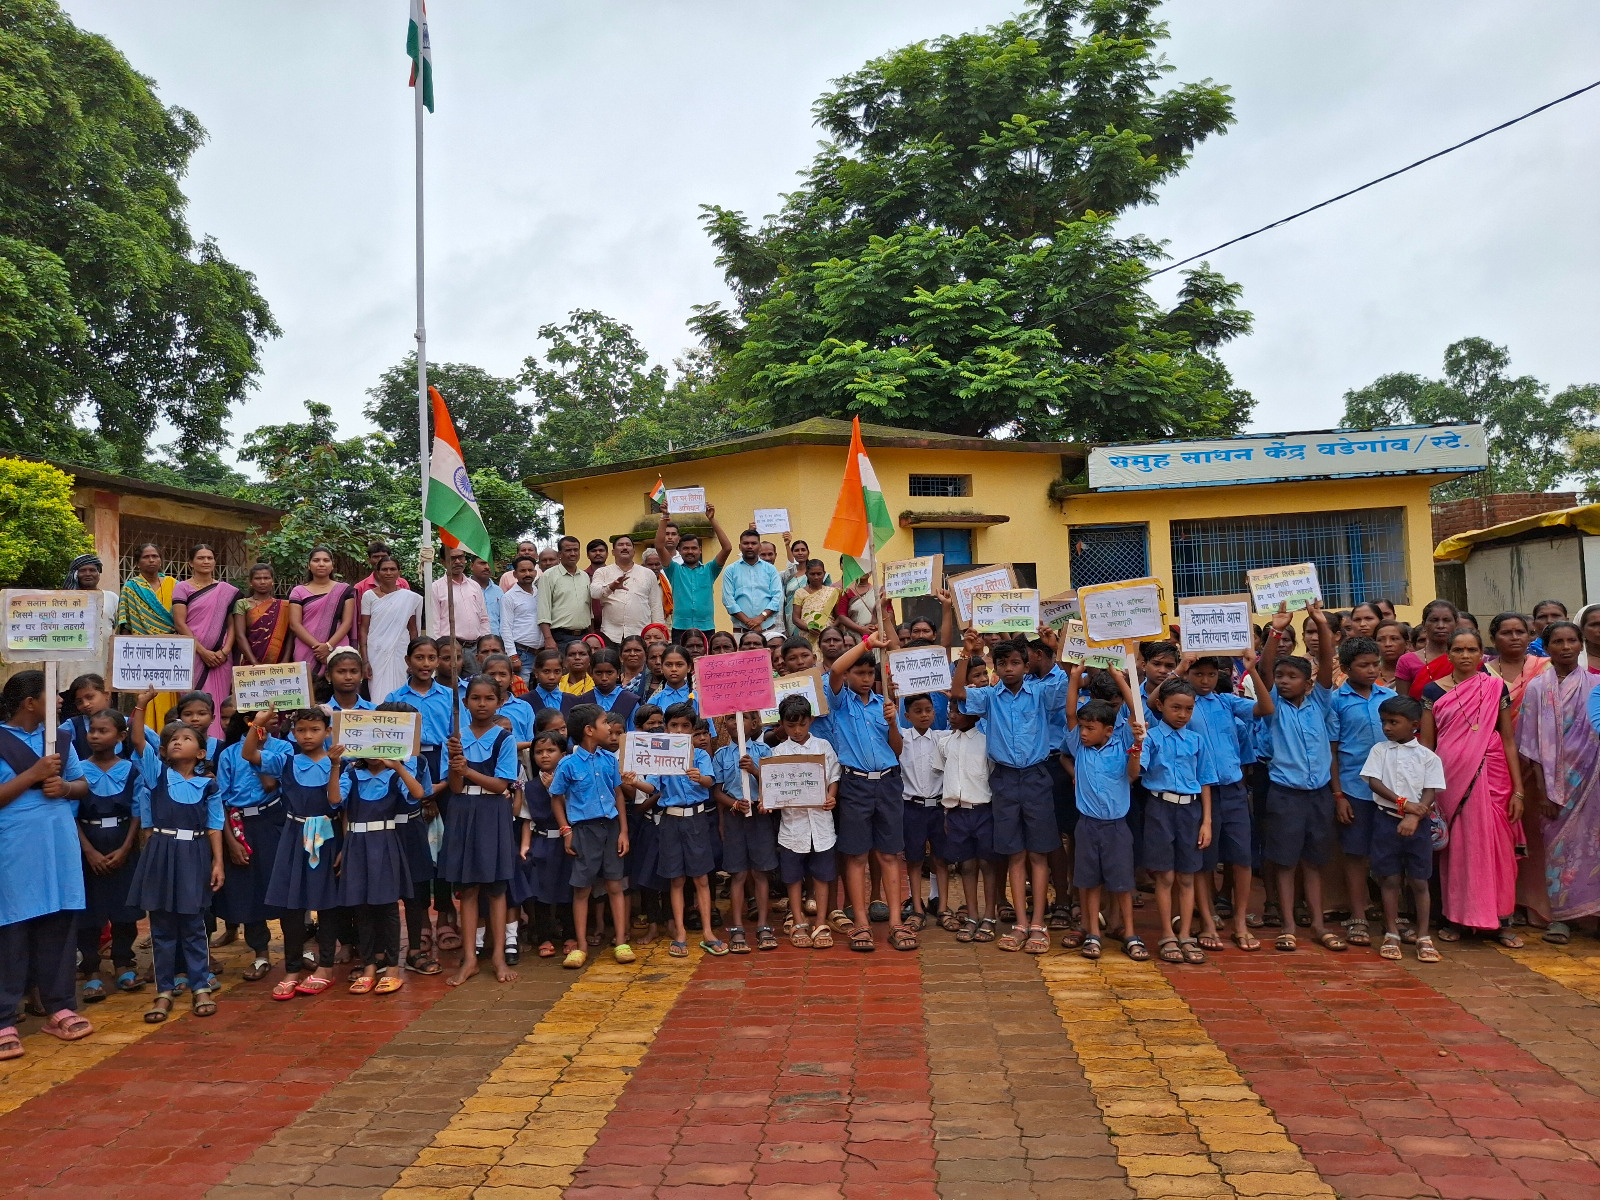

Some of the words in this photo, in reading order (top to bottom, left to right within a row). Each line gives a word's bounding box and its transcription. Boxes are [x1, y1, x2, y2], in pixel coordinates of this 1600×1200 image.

[1181, 447, 1253, 465] साधन
[1263, 441, 1307, 461] केंद्र
[79, 610, 84, 619] है
[977, 606, 993, 615] एक
[1001, 603, 1030, 613] तिरंगा
[978, 619, 994, 627] एक
[1227, 612, 1241, 623] आस
[41, 622, 59, 631] तिरंगा
[1188, 633, 1200, 647] हाच
[123, 642, 135, 659] तीन
[155, 643, 167, 660] प्रिय
[1068, 651, 1085, 659] एक
[120, 663, 142, 681] घरोघरी
[173, 664, 190, 681] तिरंगा
[780, 681, 800, 689] साथ
[344, 714, 363, 723] एक
[372, 715, 399, 724] साथ
[344, 728, 363, 738] एक
[372, 727, 405, 740] तिरंगा
[344, 743, 363, 752] एक
[372, 745, 403, 754] भारत
[636, 750, 651, 767] वंदे
[654, 755, 687, 772] मातरम्
